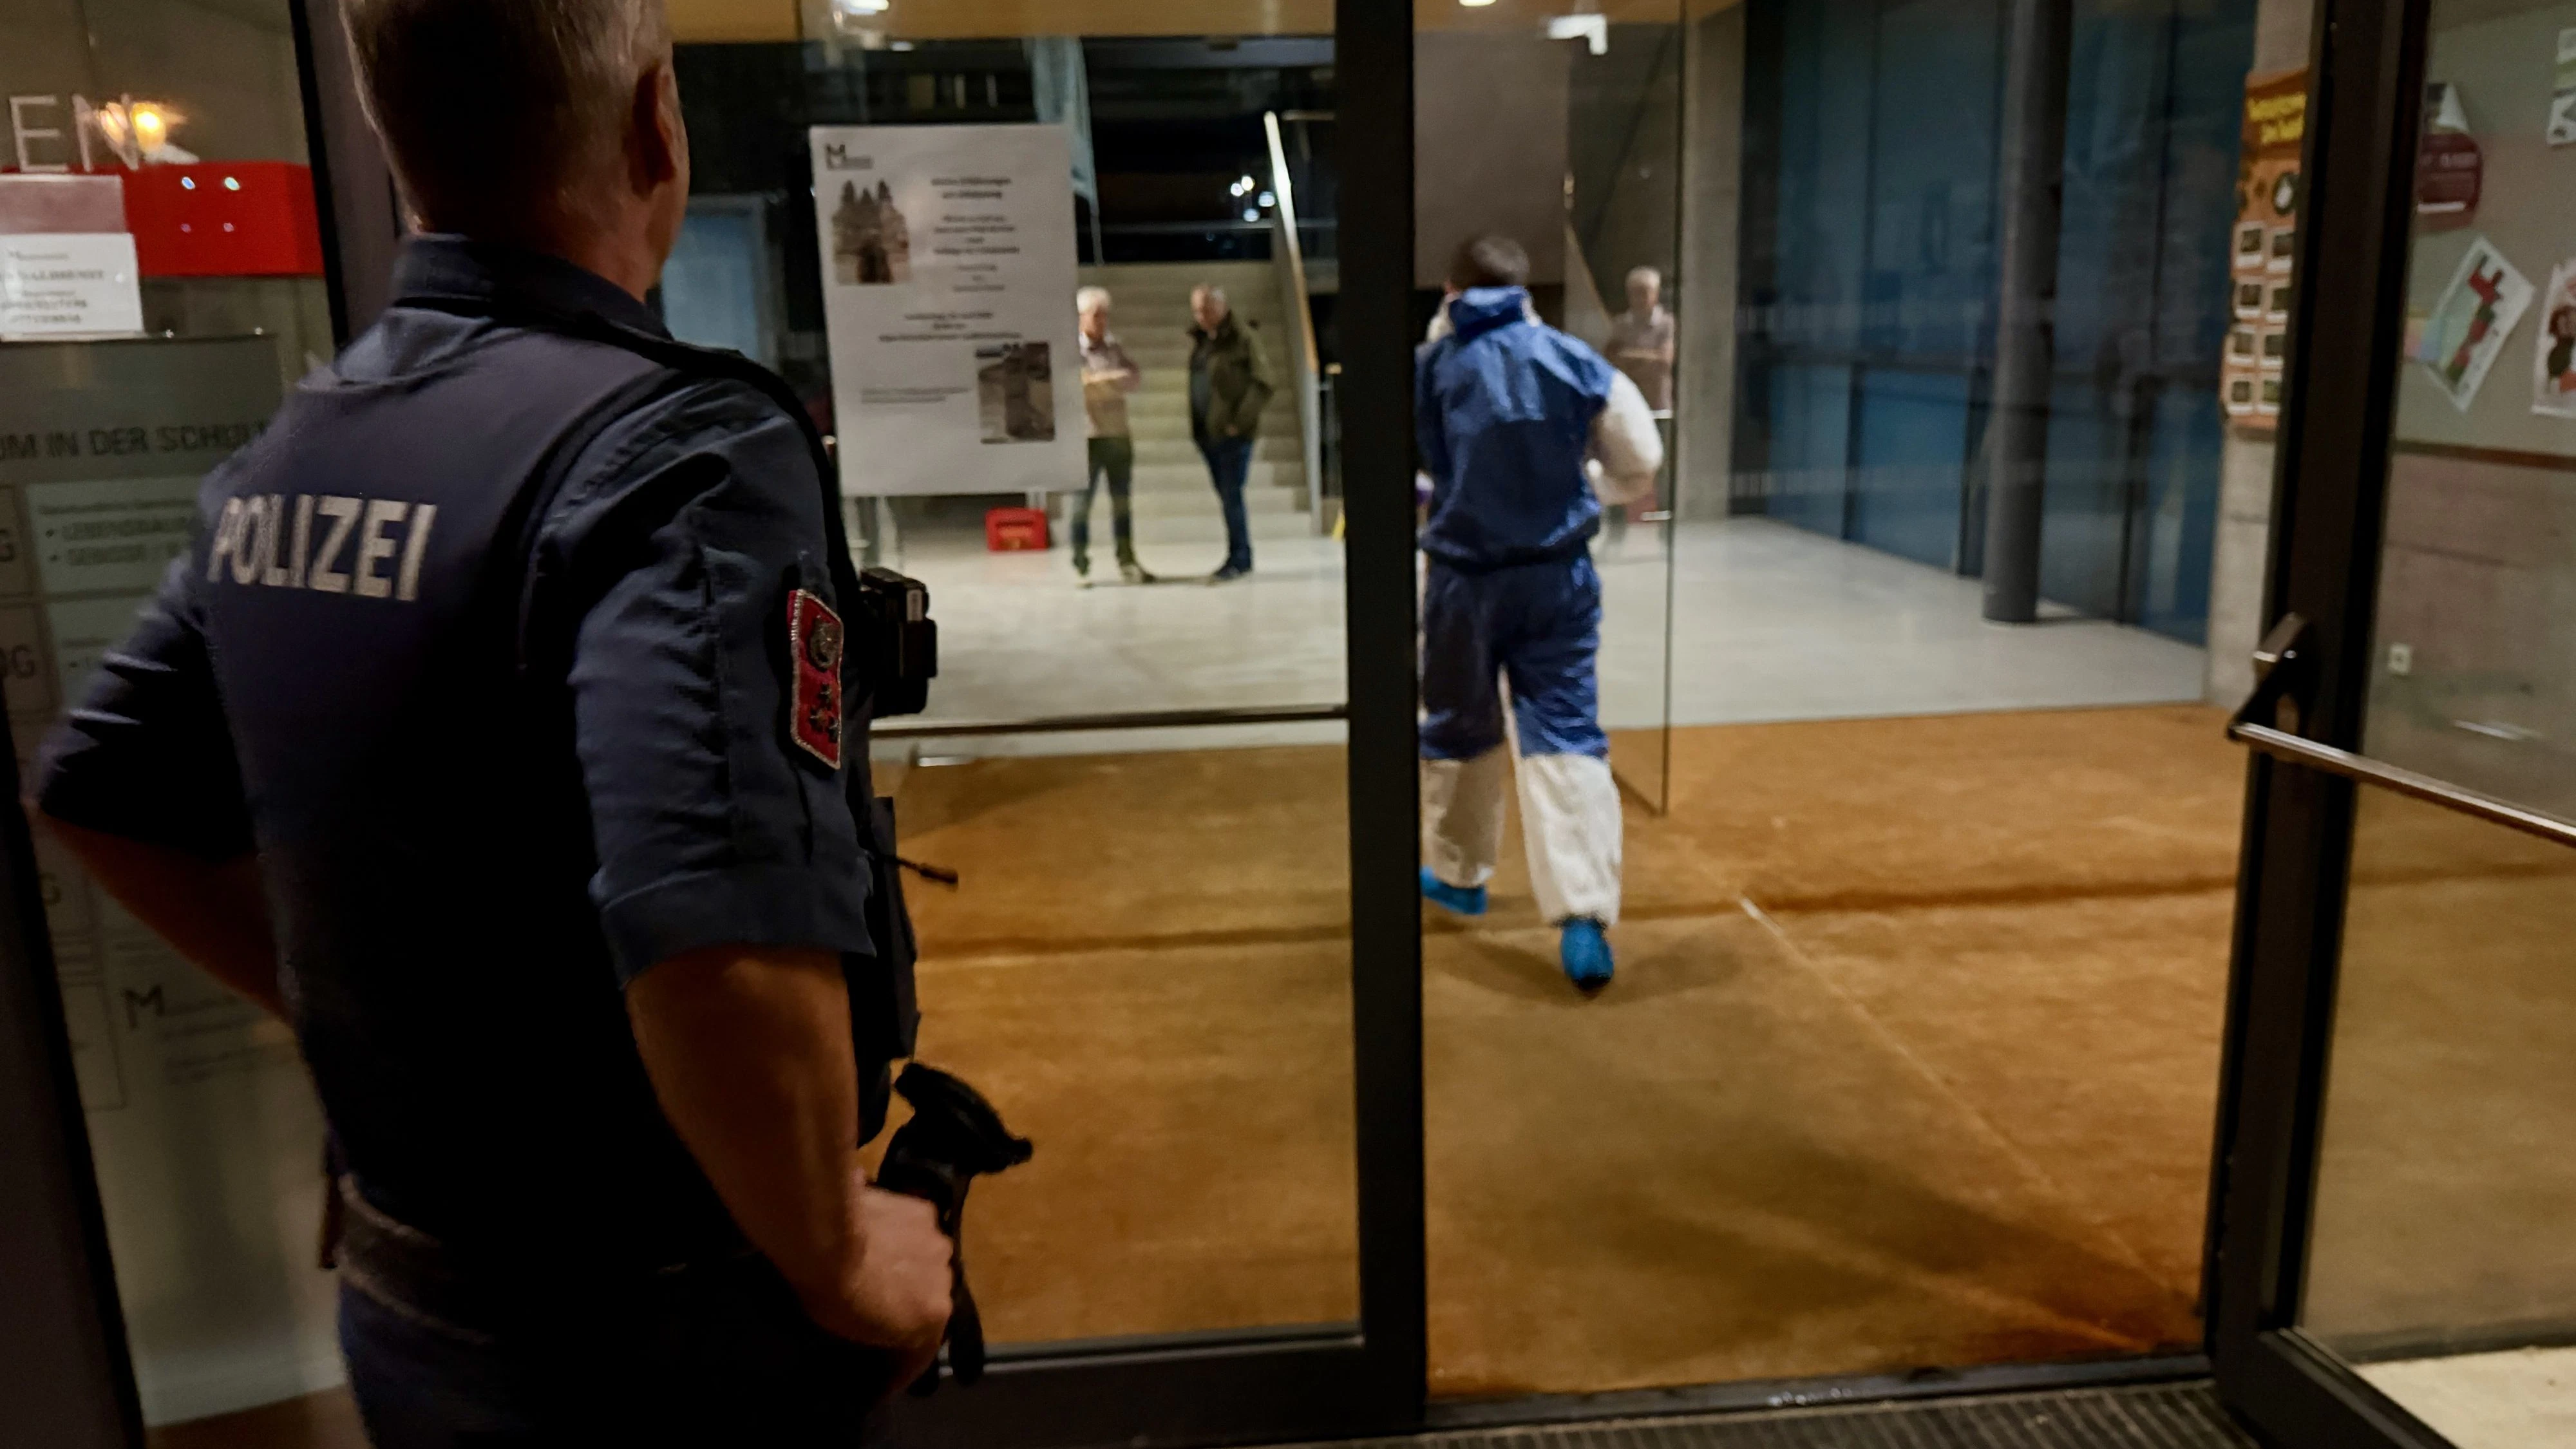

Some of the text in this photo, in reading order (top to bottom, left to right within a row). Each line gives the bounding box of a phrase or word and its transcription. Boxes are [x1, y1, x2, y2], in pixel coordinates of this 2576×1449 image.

[45, 430, 80, 458] IN
[89, 426, 149, 456] DER
[207, 493, 438, 602] POLIZEI
